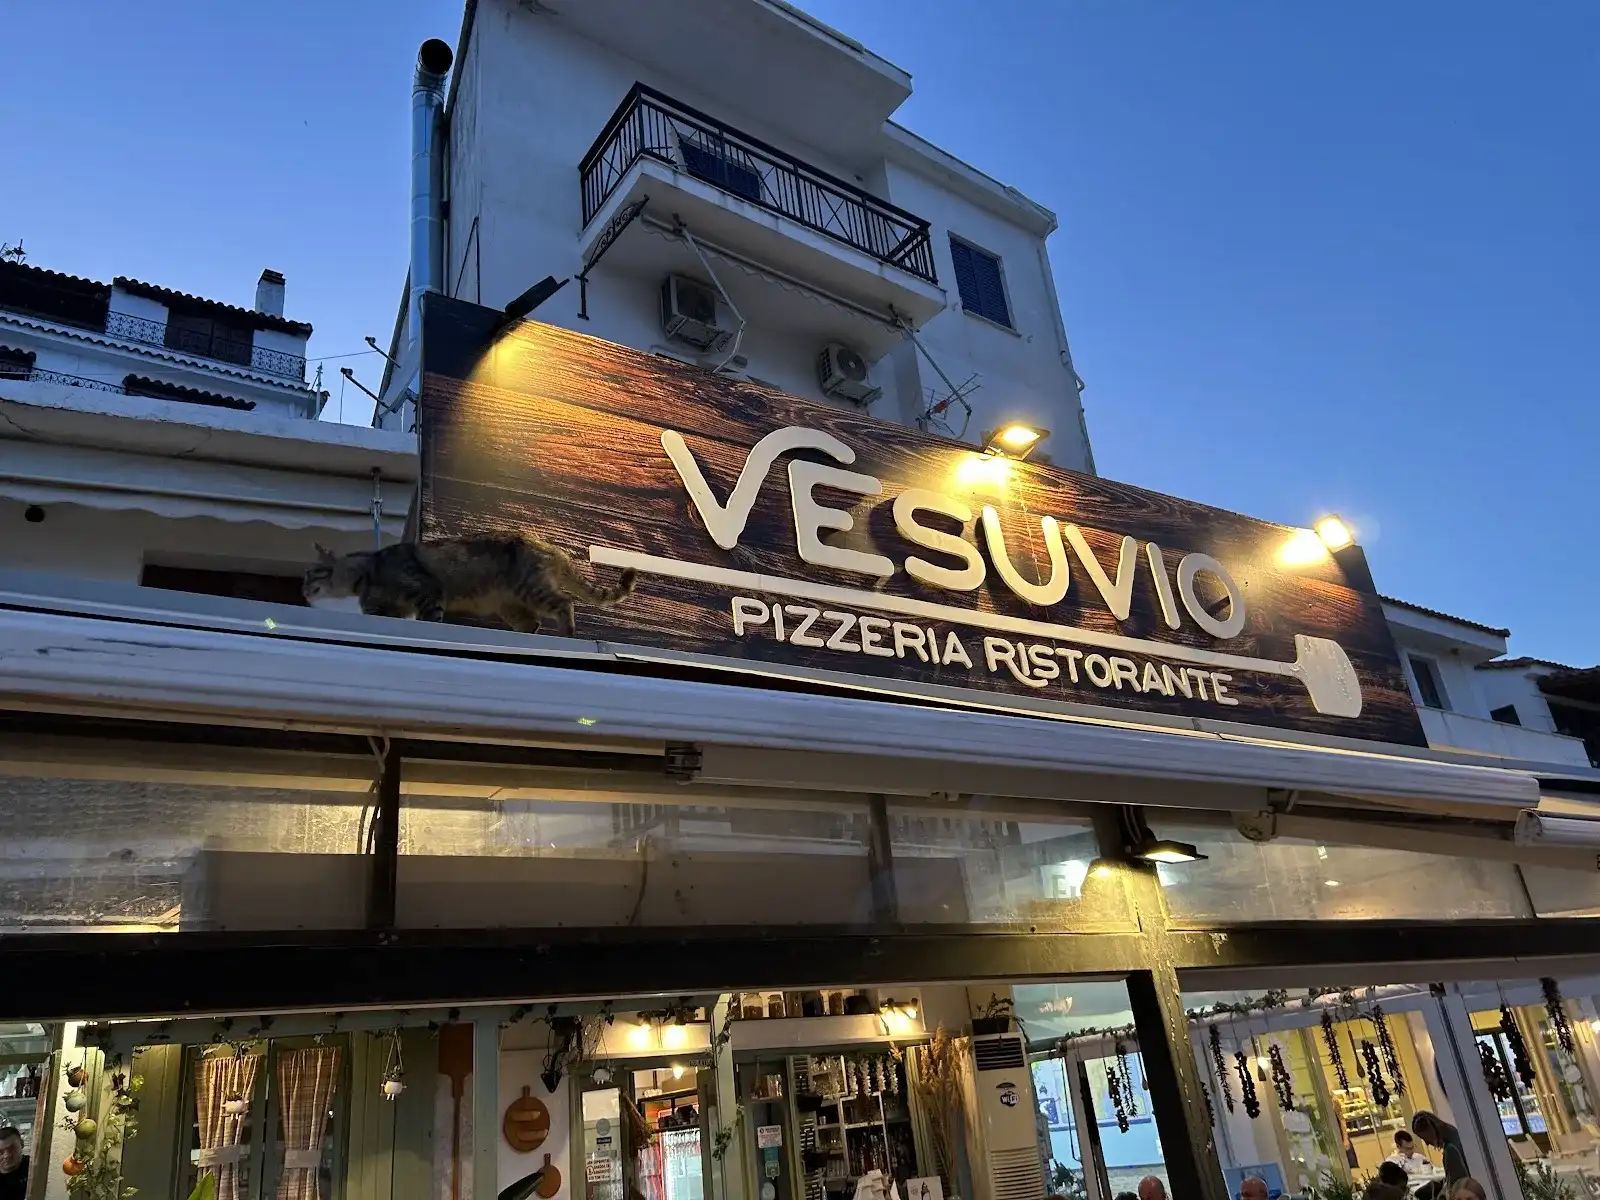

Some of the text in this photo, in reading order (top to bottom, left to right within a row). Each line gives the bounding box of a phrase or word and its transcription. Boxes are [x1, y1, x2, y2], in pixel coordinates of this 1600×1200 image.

[662, 427, 1246, 639] VESUVIO
[731, 597, 1239, 706] PIZZERIA RISTORANTE
